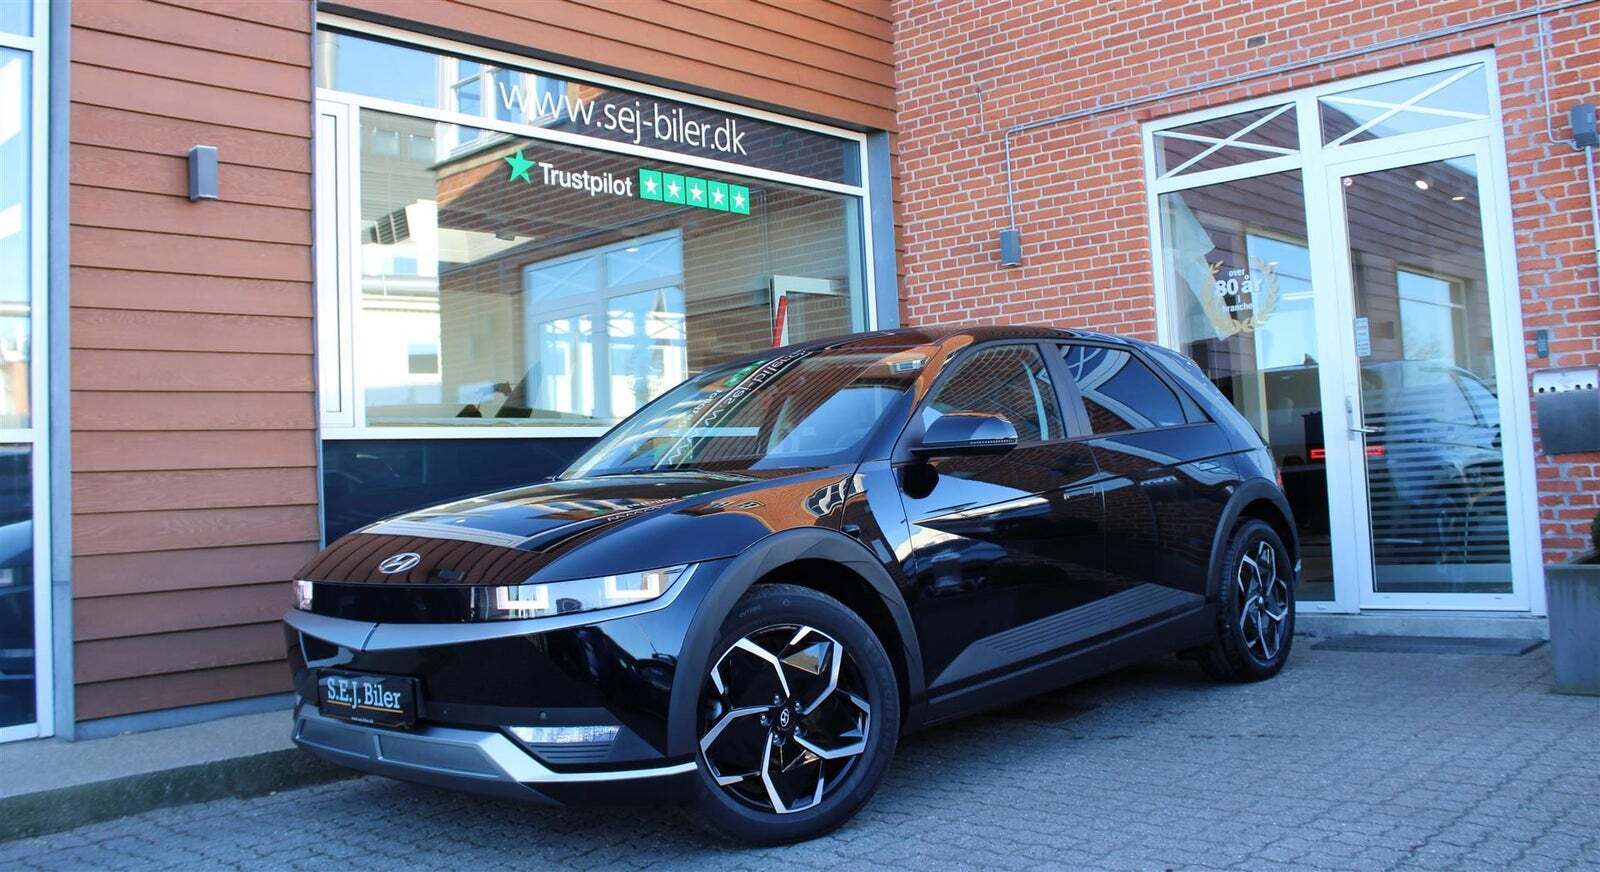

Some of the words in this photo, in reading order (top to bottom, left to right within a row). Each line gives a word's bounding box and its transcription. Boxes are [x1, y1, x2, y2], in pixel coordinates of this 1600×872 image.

[499, 81, 747, 155] www.sej-biler.dk
[538, 162, 633, 197] Trustpilot
[1215, 279, 1238, 296] 80
[1241, 274, 1260, 293] år
[1228, 269, 1245, 277] over
[1222, 302, 1256, 312] branche
[327, 678, 361, 709] S.E.J.
[363, 682, 401, 708] Biler
